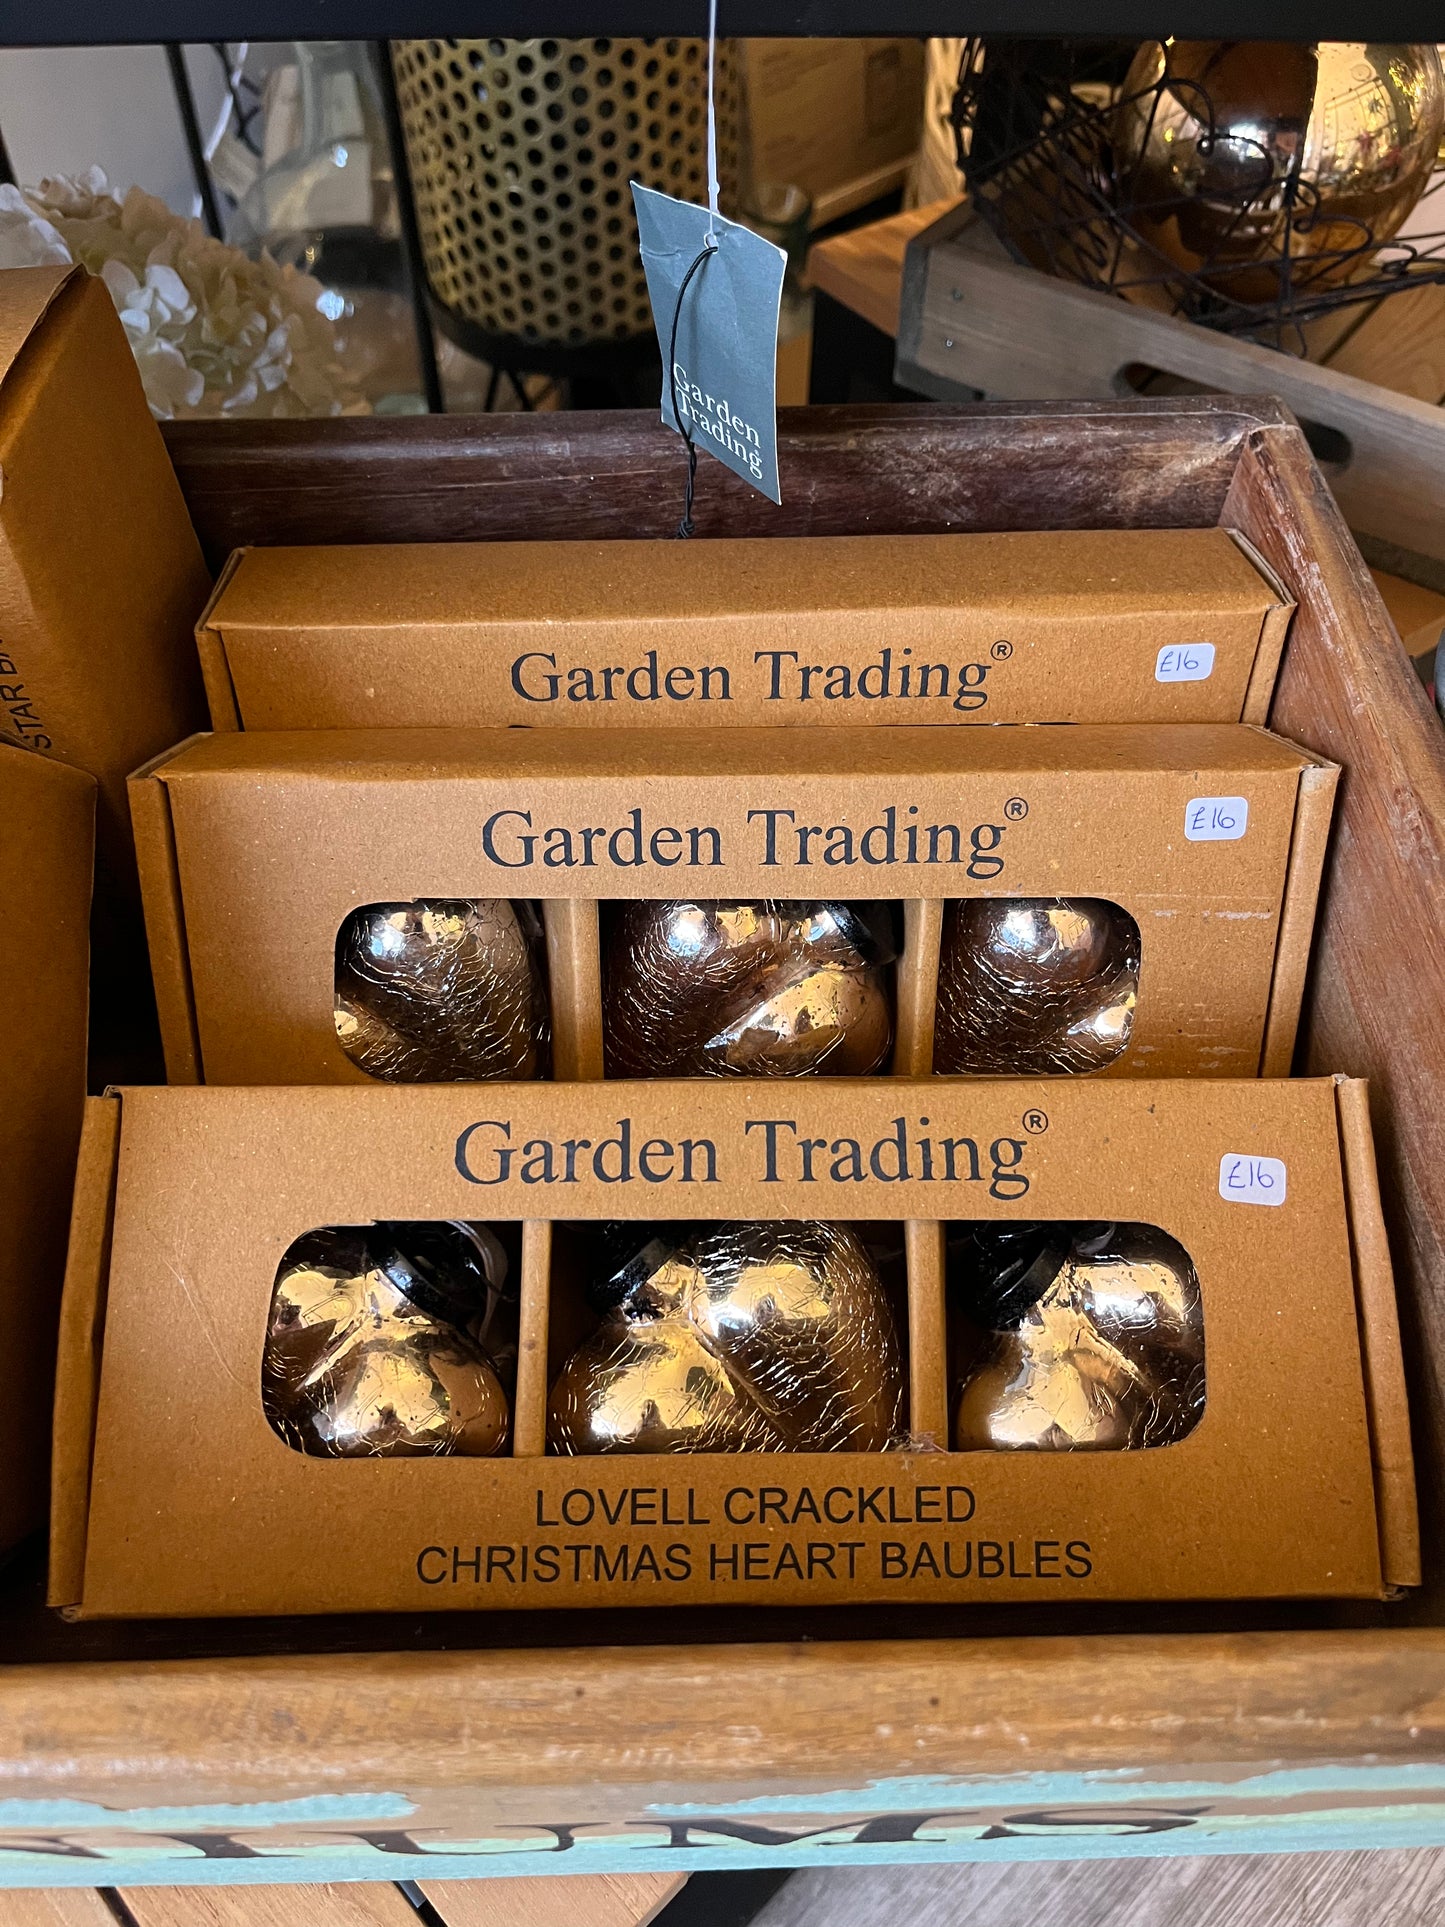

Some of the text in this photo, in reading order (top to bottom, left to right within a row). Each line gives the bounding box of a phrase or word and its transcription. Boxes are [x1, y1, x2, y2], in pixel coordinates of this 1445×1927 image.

[674, 363, 761, 448] Garden
[510, 650, 734, 702] Garden
[1160, 650, 1199, 672] £16
[0, 684, 52, 749] STAR
[482, 808, 726, 868] Garden
[1191, 806, 1235, 830] £16
[454, 1118, 722, 1185] Garden
[1228, 1161, 1274, 1188] £16
[536, 1485, 976, 1526] LOVELL CRACKLED
[416, 1540, 1093, 1584] CHRISTMAS HEART BAUBLES
